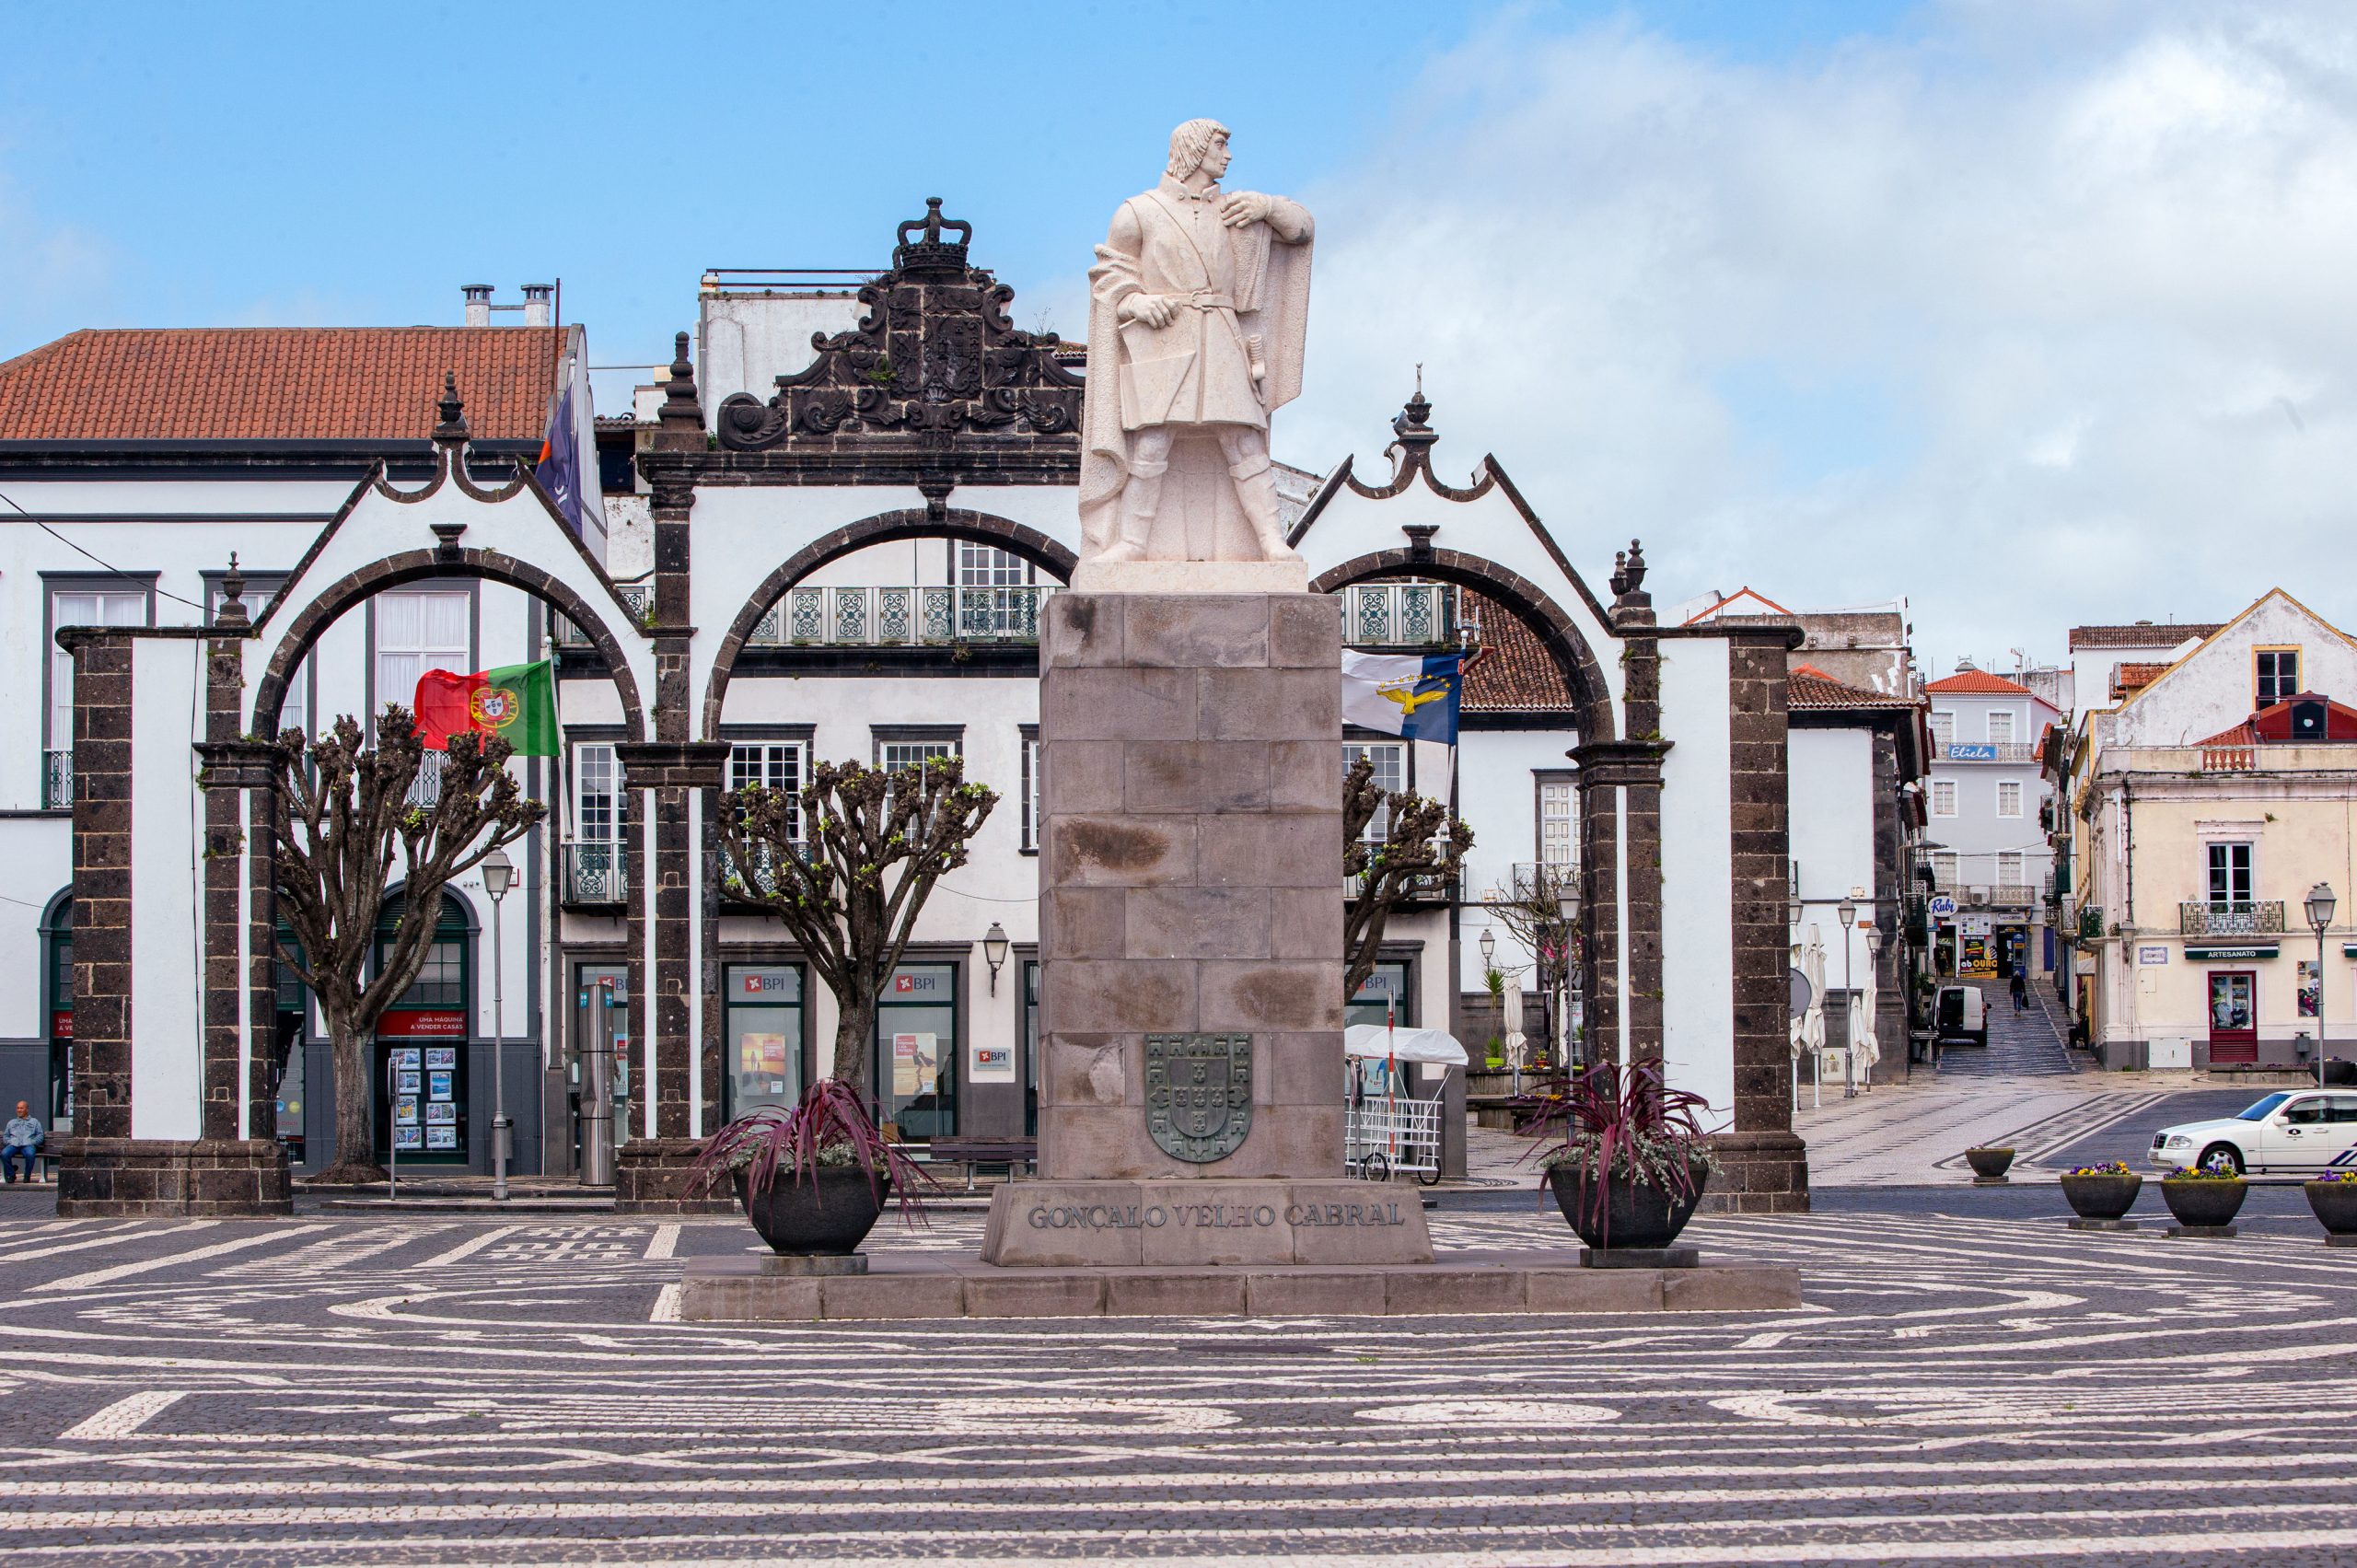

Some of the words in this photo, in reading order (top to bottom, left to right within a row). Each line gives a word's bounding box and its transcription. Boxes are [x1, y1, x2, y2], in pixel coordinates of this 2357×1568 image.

[1932, 898, 1954, 913] Rubi
[2208, 950, 2257, 958] ARTESANATO
[1973, 959, 1997, 968] OURO
[763, 978, 784, 990] BPI
[913, 977, 935, 990] BPI
[1365, 976, 1387, 989] BPI
[991, 1051, 1006, 1061] BPI
[1028, 1204, 1167, 1233] GONÇALO
[1172, 1203, 1276, 1228] VELHO
[1284, 1202, 1405, 1226] CABRAL
